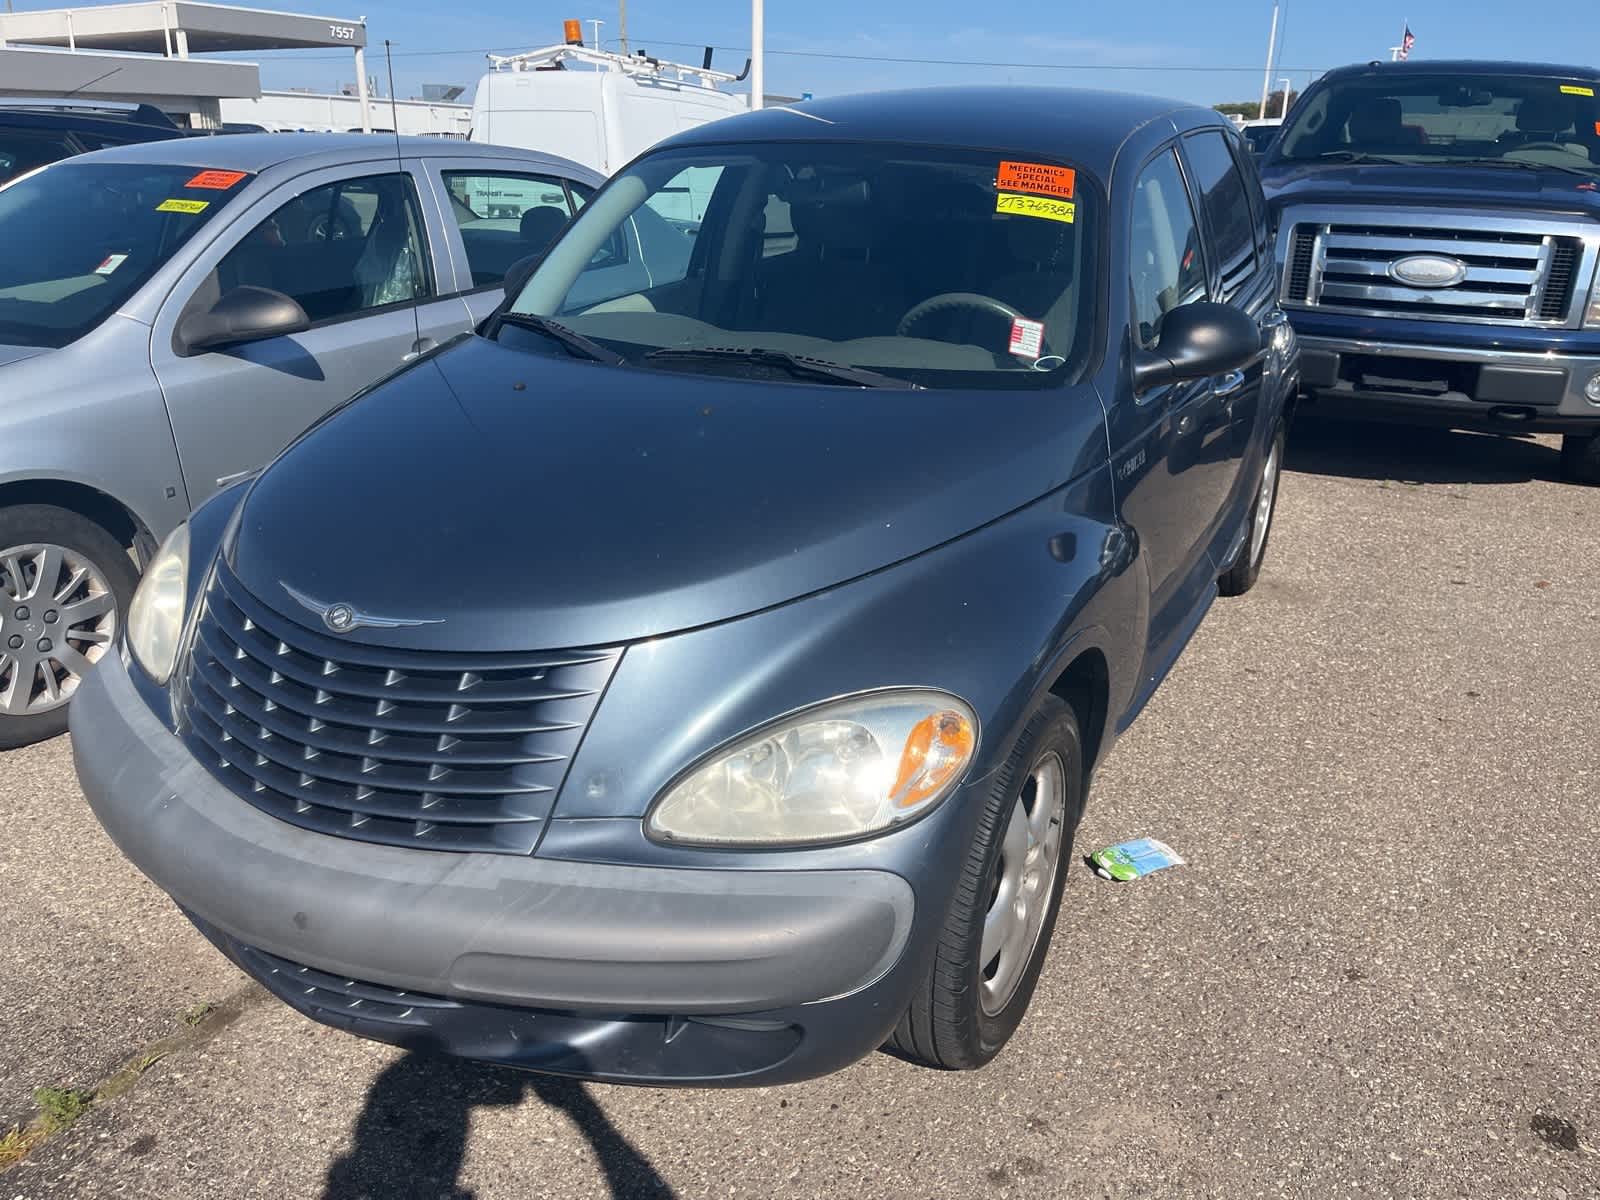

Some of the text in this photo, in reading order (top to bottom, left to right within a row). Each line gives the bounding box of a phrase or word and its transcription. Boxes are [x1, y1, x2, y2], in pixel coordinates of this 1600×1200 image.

[329, 25, 354, 39] 7557
[1009, 164, 1065, 177] MECHANICS
[1016, 172, 1056, 184] SPECIAL
[1000, 179, 1070, 195] SEE MANAGER
